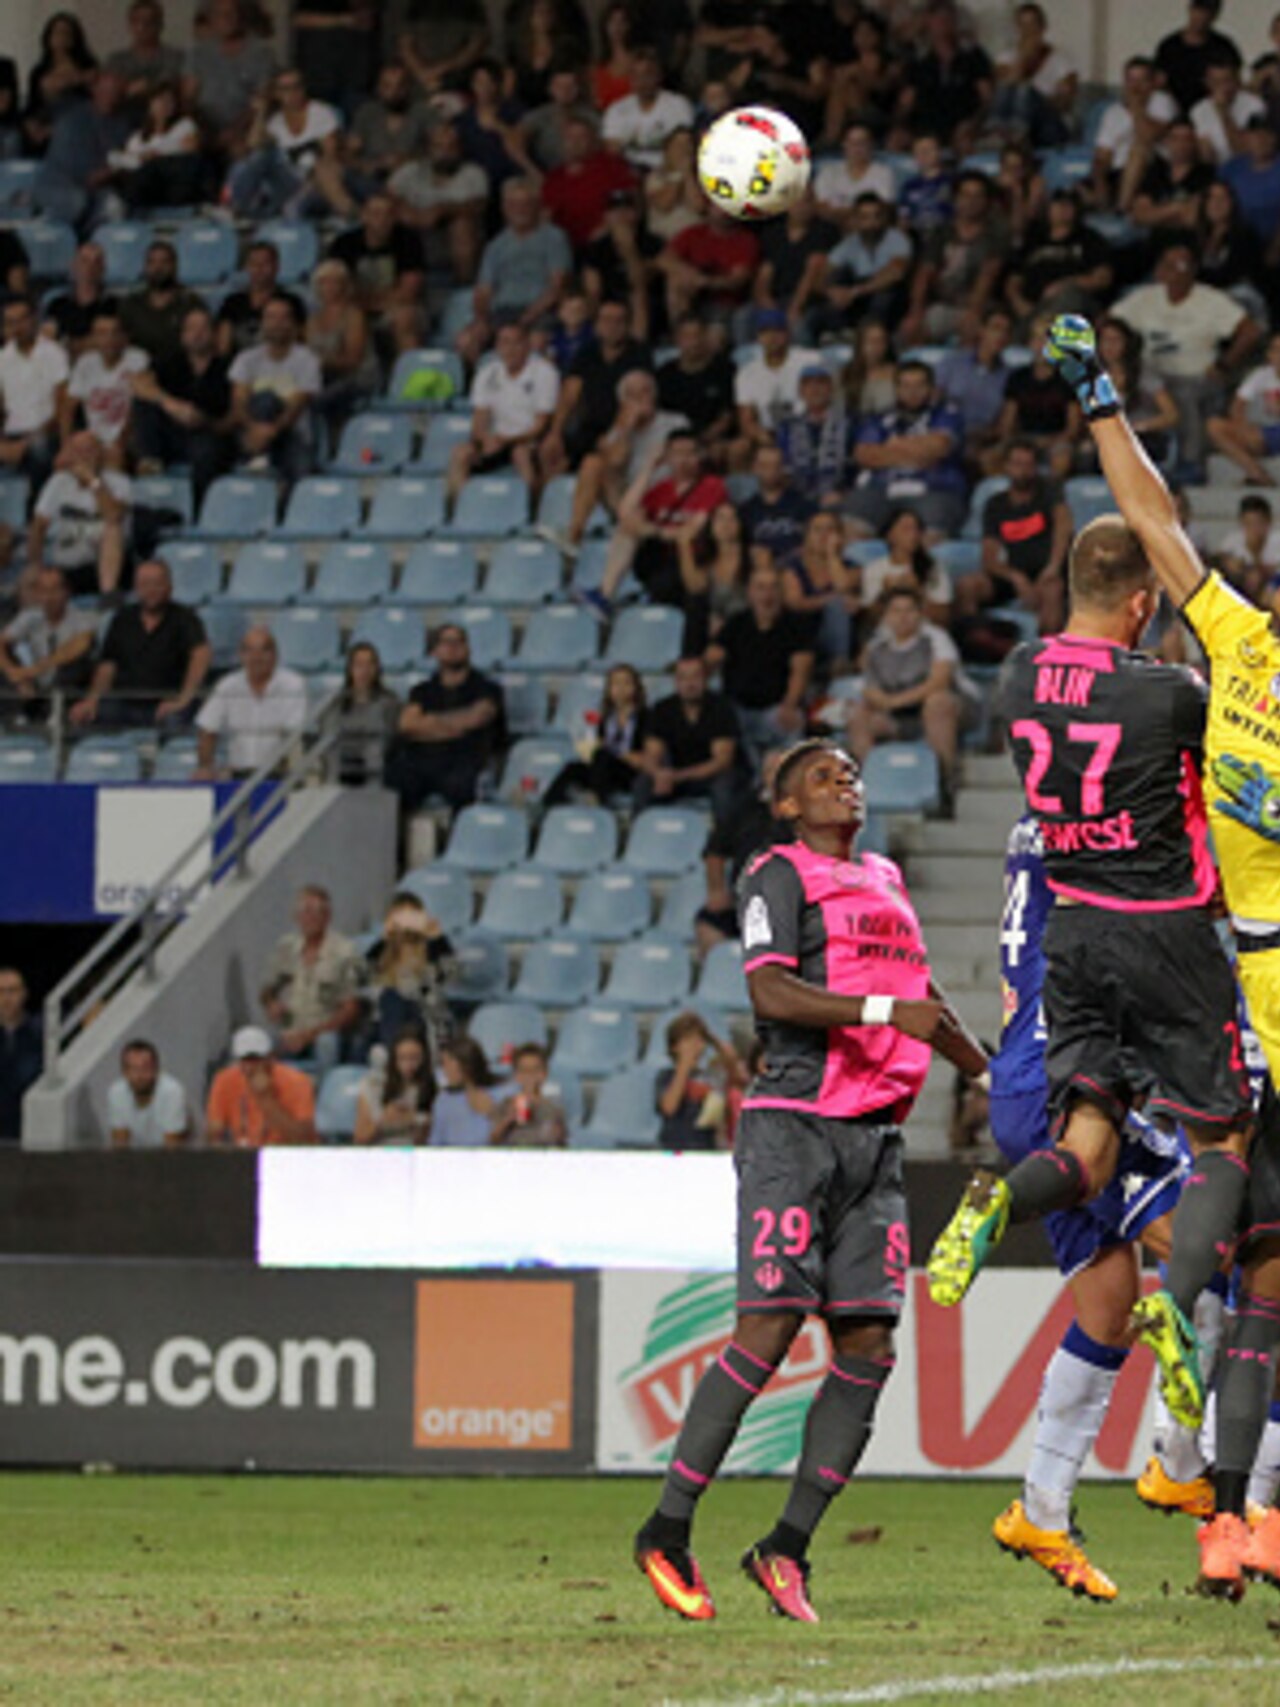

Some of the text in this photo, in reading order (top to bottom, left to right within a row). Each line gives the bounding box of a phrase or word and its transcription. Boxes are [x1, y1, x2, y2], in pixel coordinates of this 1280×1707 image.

[1011, 719, 1122, 816] 27
[752, 1206, 812, 1259] 29
[422, 1405, 555, 1446] orange
